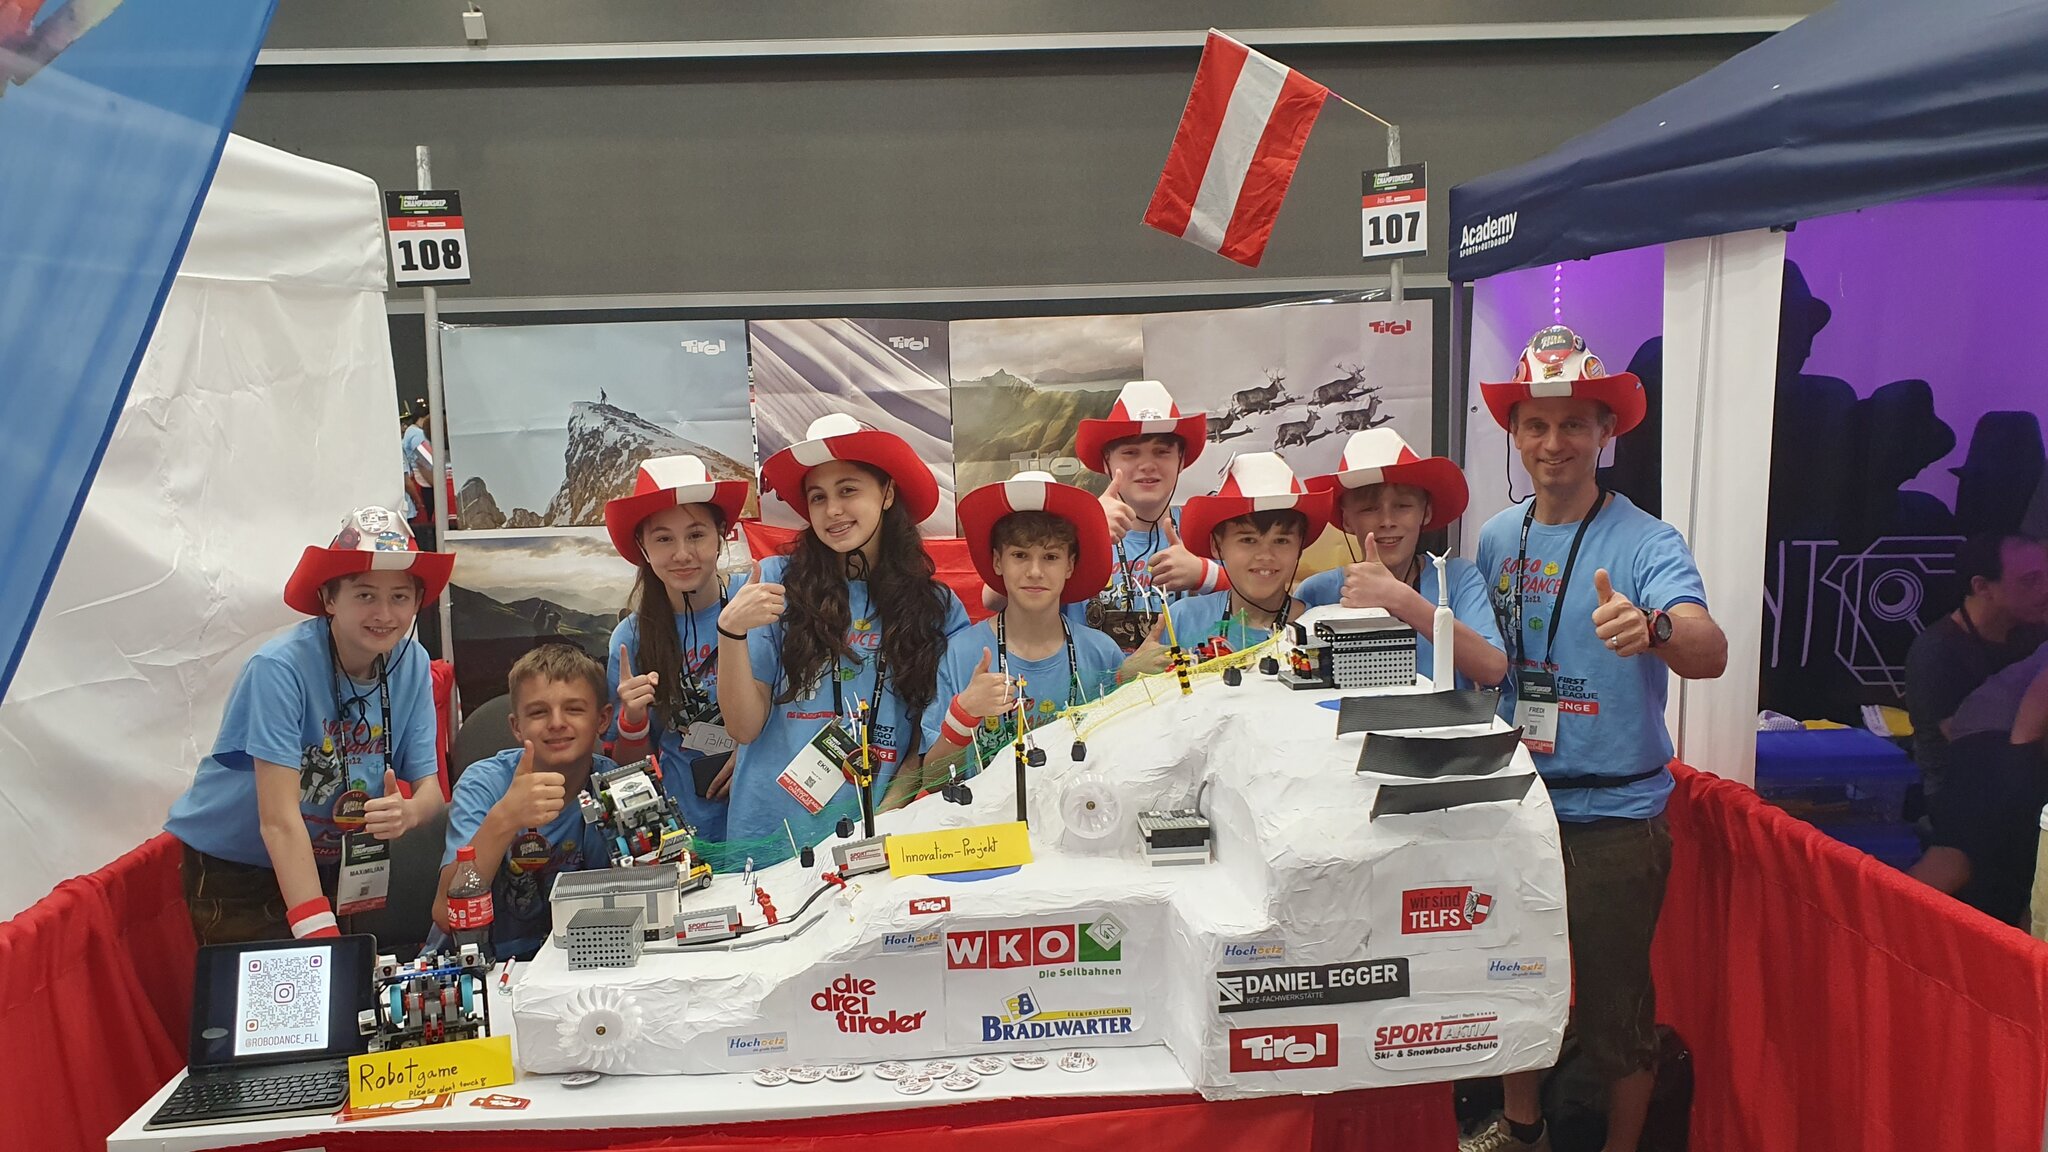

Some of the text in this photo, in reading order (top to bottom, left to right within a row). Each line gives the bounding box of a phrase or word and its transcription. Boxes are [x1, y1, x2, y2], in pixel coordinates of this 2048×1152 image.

[1369, 211, 1420, 246] 107
[1460, 211, 1518, 249] Academy
[398, 239, 462, 271] 108
[816, 759, 832, 774] EKIN
[901, 836, 998, 862] Innovation-Projekt
[1410, 891, 1460, 909] wir sind
[1409, 909, 1461, 929] TELFS
[948, 930, 1070, 964] WKO
[832, 974, 876, 996] die
[1039, 967, 1122, 979] Die Seilbahnen
[1245, 963, 1398, 994] DANIEL EGGER
[811, 987, 869, 1015] drei
[1067, 1008, 1130, 1017] ELEKTROTECHNIK
[835, 1009, 927, 1034] tiroler
[982, 1016, 1132, 1042] BRADLWARTER
[245, 1033, 319, 1048] @ROBODANCE_FLL
[1375, 1041, 1498, 1060] Ski- & Snowboard-Schule
